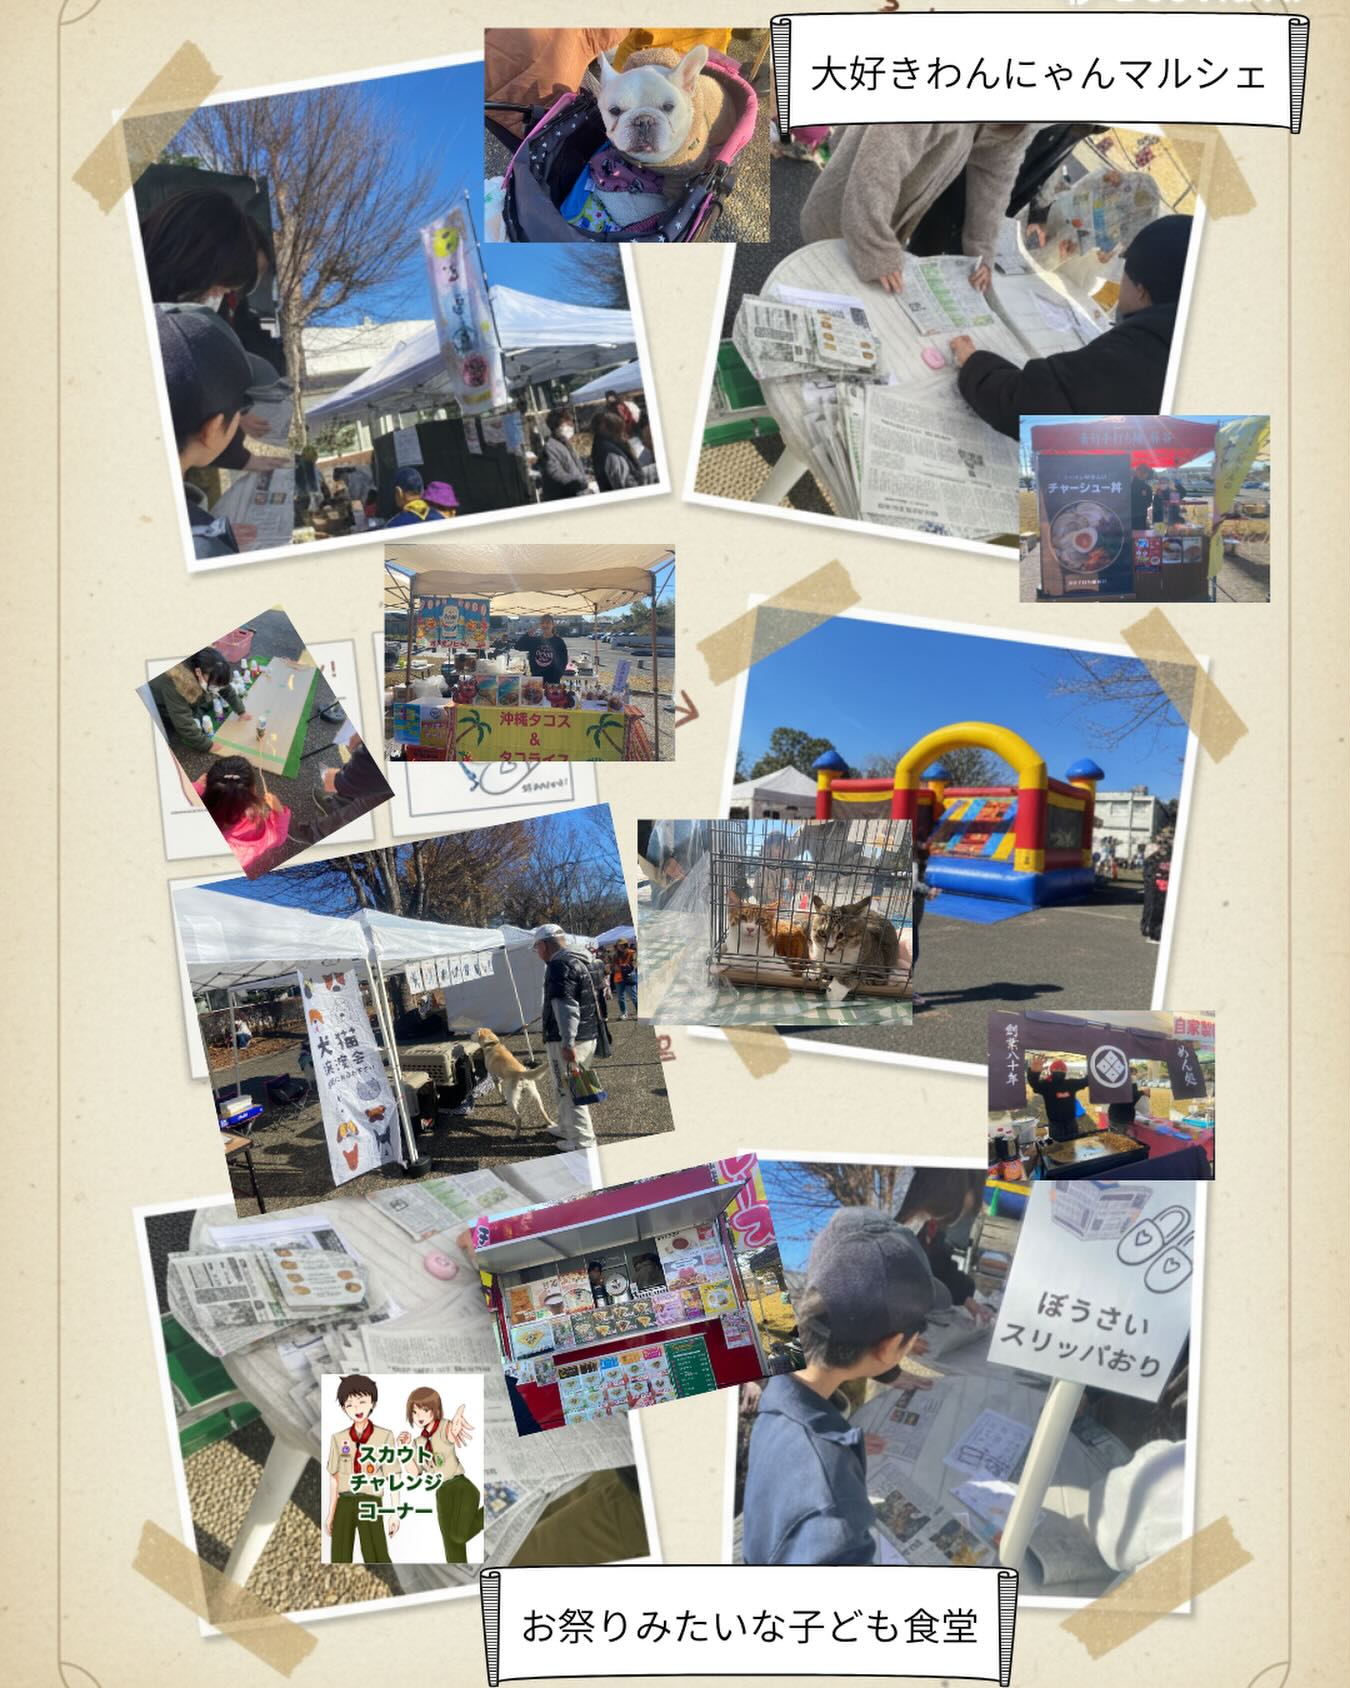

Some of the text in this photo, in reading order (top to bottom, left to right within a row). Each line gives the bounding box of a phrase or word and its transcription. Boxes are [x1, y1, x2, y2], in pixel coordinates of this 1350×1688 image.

[1047, 481, 1122, 494] チャーシュー丼
[499, 711, 570, 728] 沖縄タコス
[529, 731, 541, 746] &
[1174, 1016, 1215, 1037] 自家製
[1037, 1291, 1149, 1335] ぼうさい
[1000, 1323, 1161, 1378] スリッパおり
